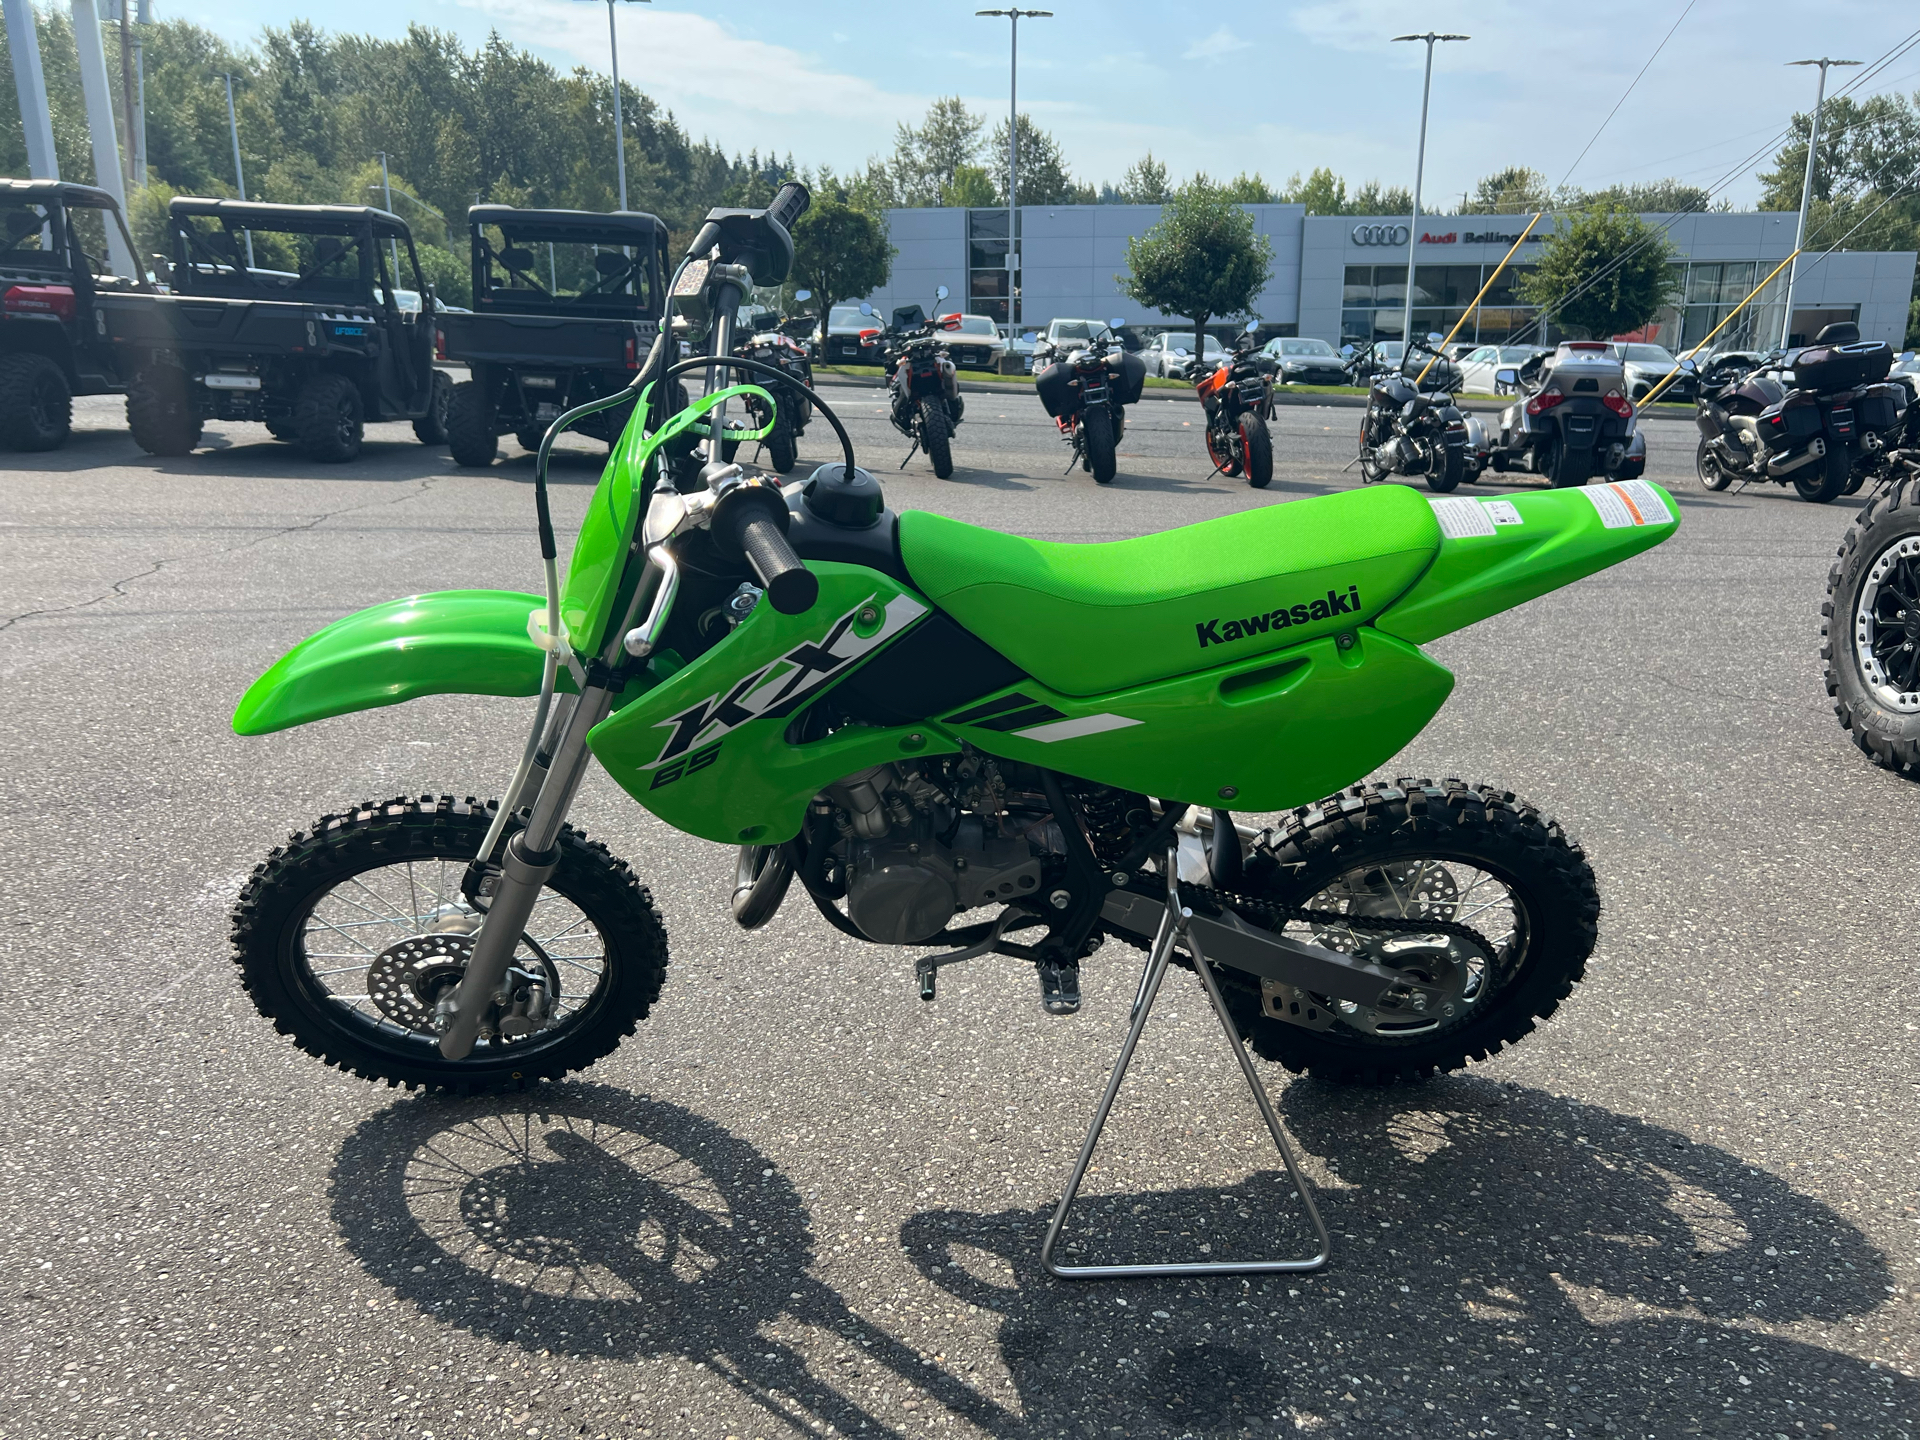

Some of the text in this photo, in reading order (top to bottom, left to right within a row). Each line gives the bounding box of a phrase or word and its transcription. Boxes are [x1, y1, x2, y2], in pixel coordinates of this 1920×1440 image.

[1418, 232, 1457, 244] Audi
[1195, 584, 1362, 648] Kawasaki
[656, 605, 858, 764] KX
[649, 741, 724, 791] 65
